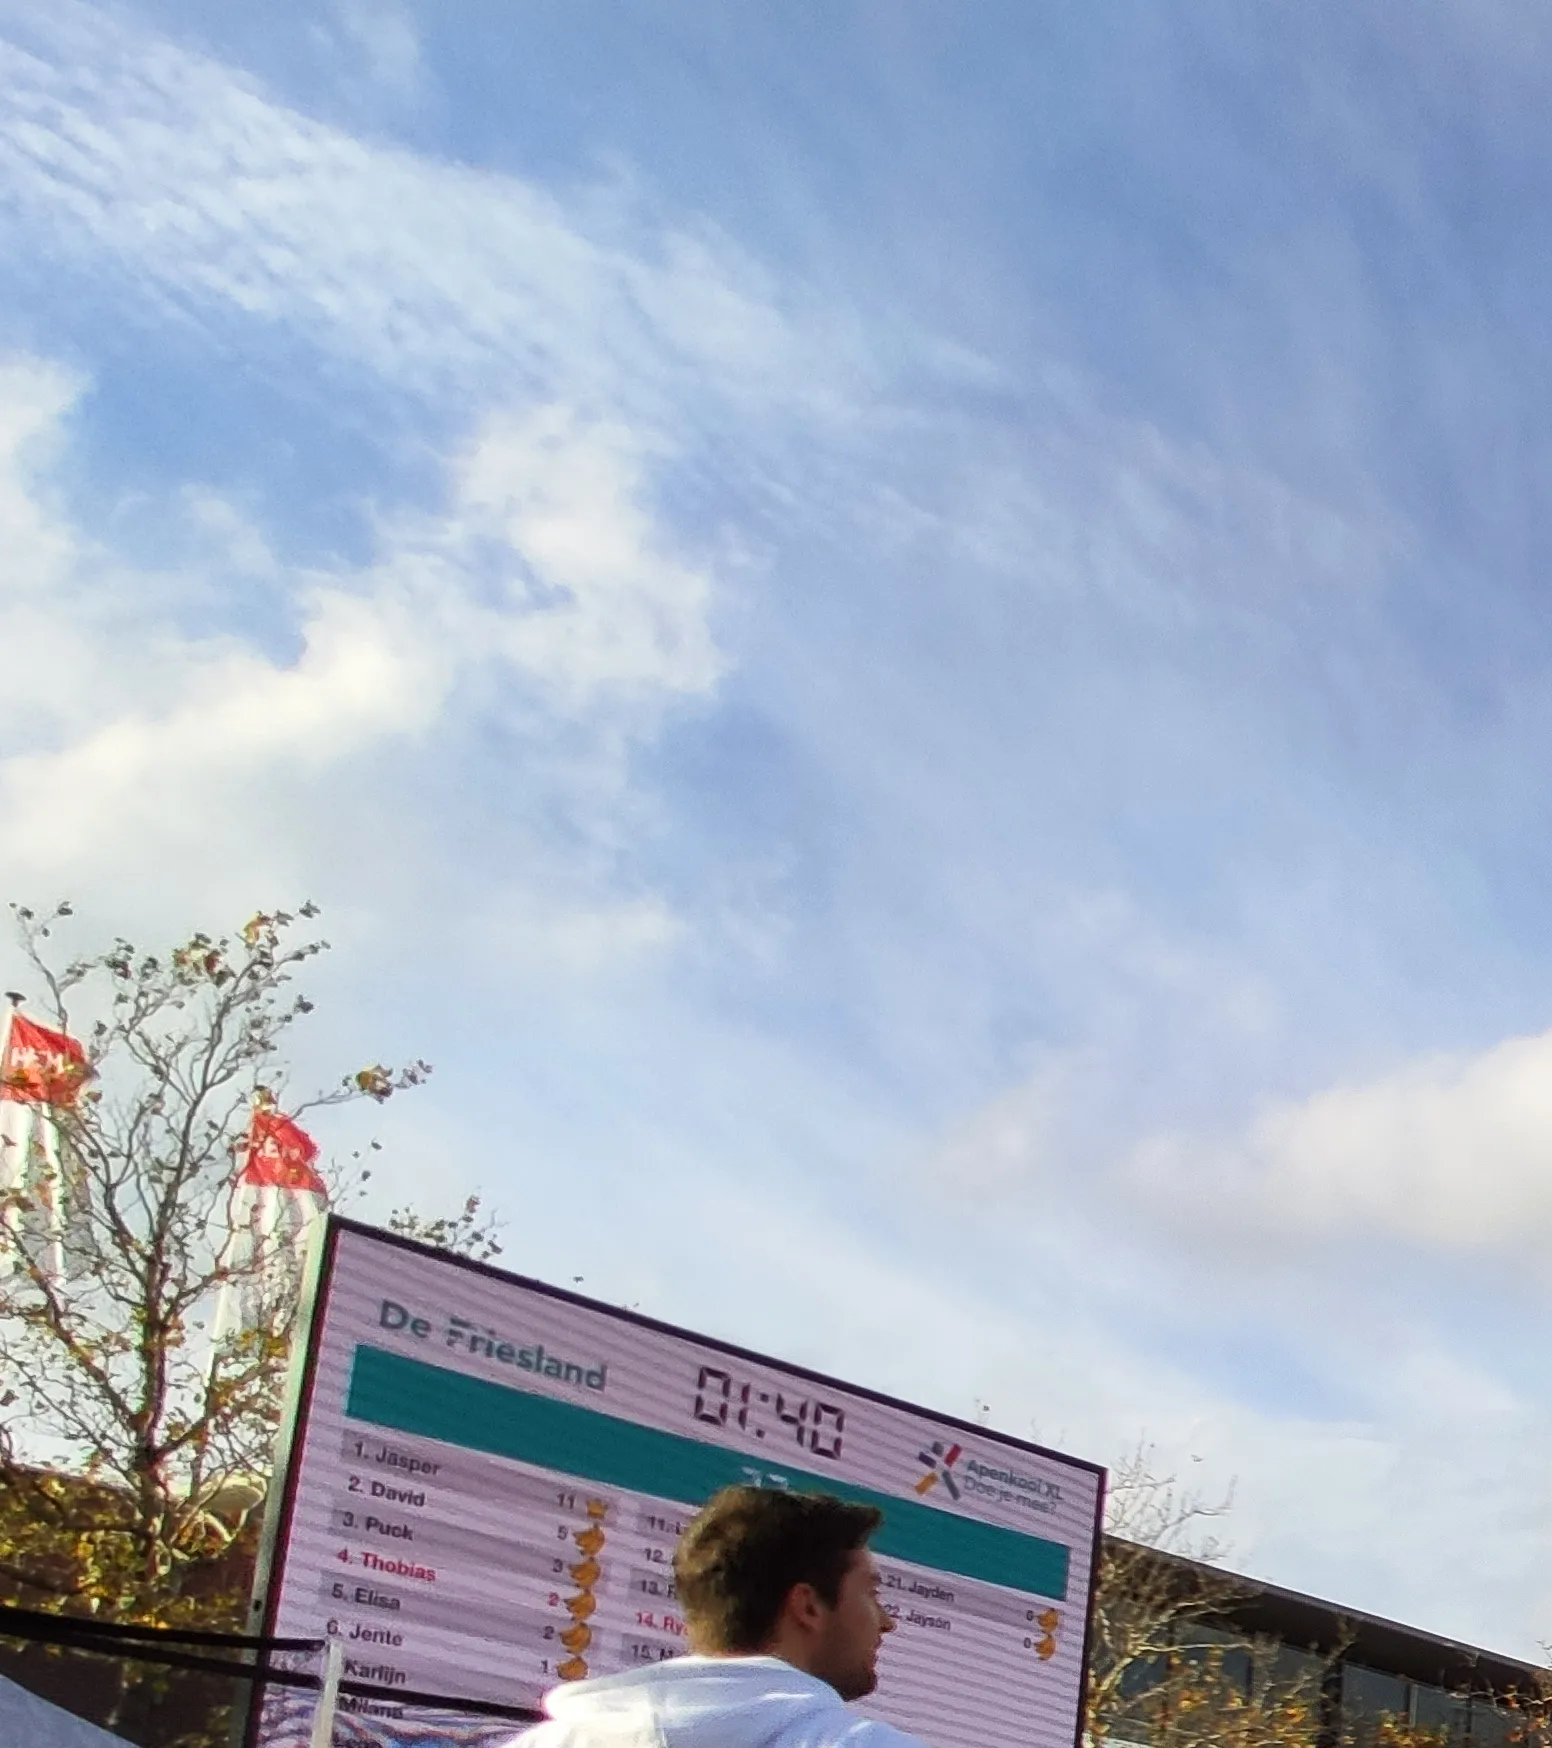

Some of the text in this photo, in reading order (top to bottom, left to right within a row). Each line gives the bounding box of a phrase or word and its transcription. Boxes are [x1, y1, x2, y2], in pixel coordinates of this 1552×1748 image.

[380, 1299, 608, 1391] De Friesland
[694, 1367, 844, 1460] 01:40
[354, 1441, 441, 1475] 1. Jasper
[371, 1481, 425, 1507] David
[557, 1493, 576, 1511] 11
[342, 1511, 414, 1541] 3. Puck
[557, 1526, 568, 1540] 5
[337, 1547, 437, 1582] 4. Thobias
[552, 1559, 564, 1573] 3
[331, 1583, 401, 1611] 5. Elisa
[547, 1592, 560, 1607] 2
[909, 1581, 955, 1603] Jayden
[906, 1609, 951, 1630] Jayson
[350, 1624, 403, 1648] Jente
[542, 1626, 555, 1640] 2
[343, 1658, 406, 1685] Karlijn
